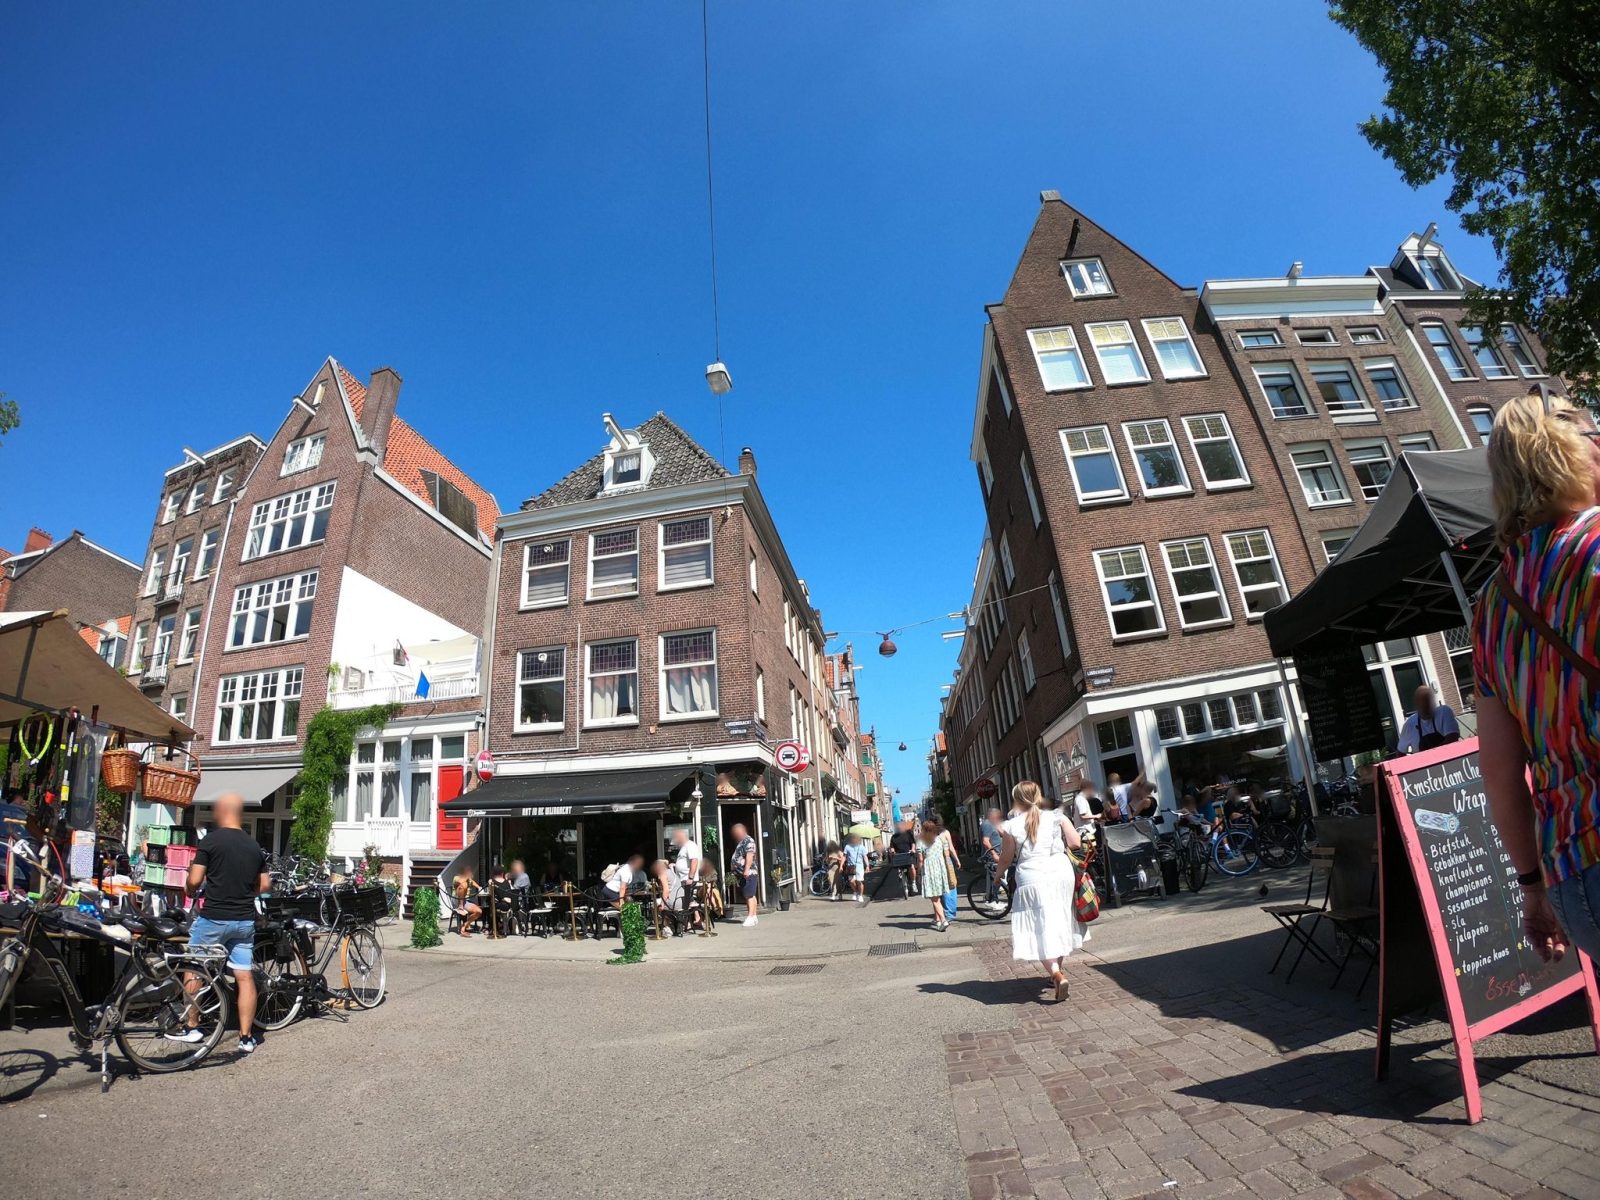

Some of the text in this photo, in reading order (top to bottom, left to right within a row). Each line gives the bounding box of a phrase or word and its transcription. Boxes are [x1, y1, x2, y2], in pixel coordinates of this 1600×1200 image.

[1403, 758, 1482, 799] Amsterdam Che
[1453, 789, 1487, 818] Wrap
[1430, 833, 1472, 858] Biefstuk
[1475, 863, 1485, 873] en
[1451, 915, 1467, 930] sla
